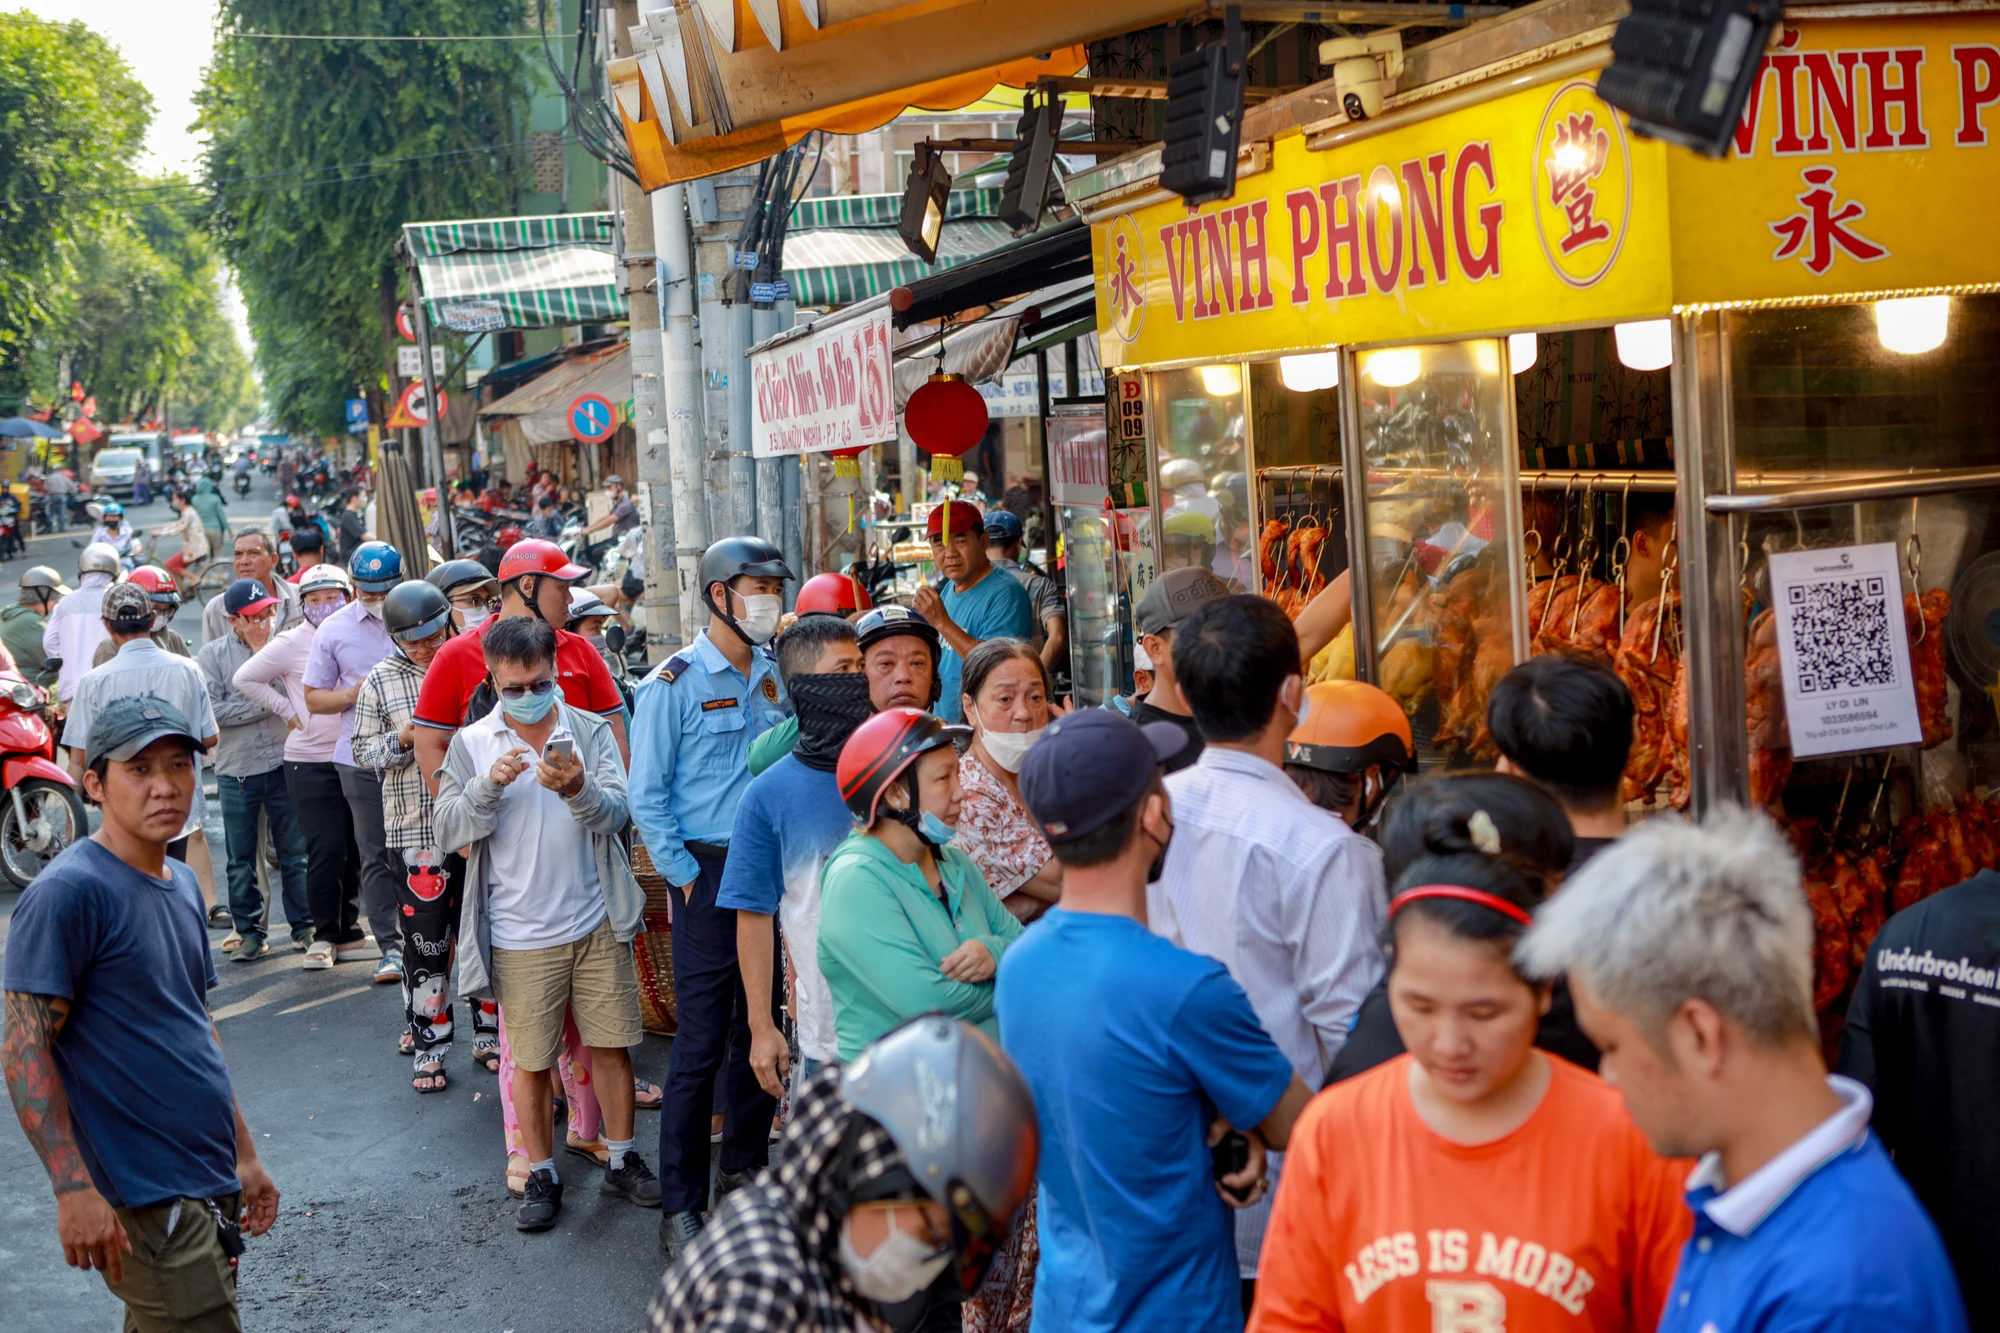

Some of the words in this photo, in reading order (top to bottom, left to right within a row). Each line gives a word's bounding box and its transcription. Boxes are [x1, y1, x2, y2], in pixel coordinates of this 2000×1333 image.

[1286, 139, 1503, 306] PHONG
[1767, 164, 1892, 276] 永
[1110, 233, 1144, 320] 永
[852, 318, 896, 438] 151
[1122, 400, 1144, 416] 09
[1123, 418, 1143, 437] 09
[1853, 697, 1869, 707] LIN
[412, 924, 453, 957] Pand
[1344, 1231, 1421, 1304] LESS
[1427, 1229, 1469, 1273] IS
[1475, 1231, 1595, 1316] MORE
